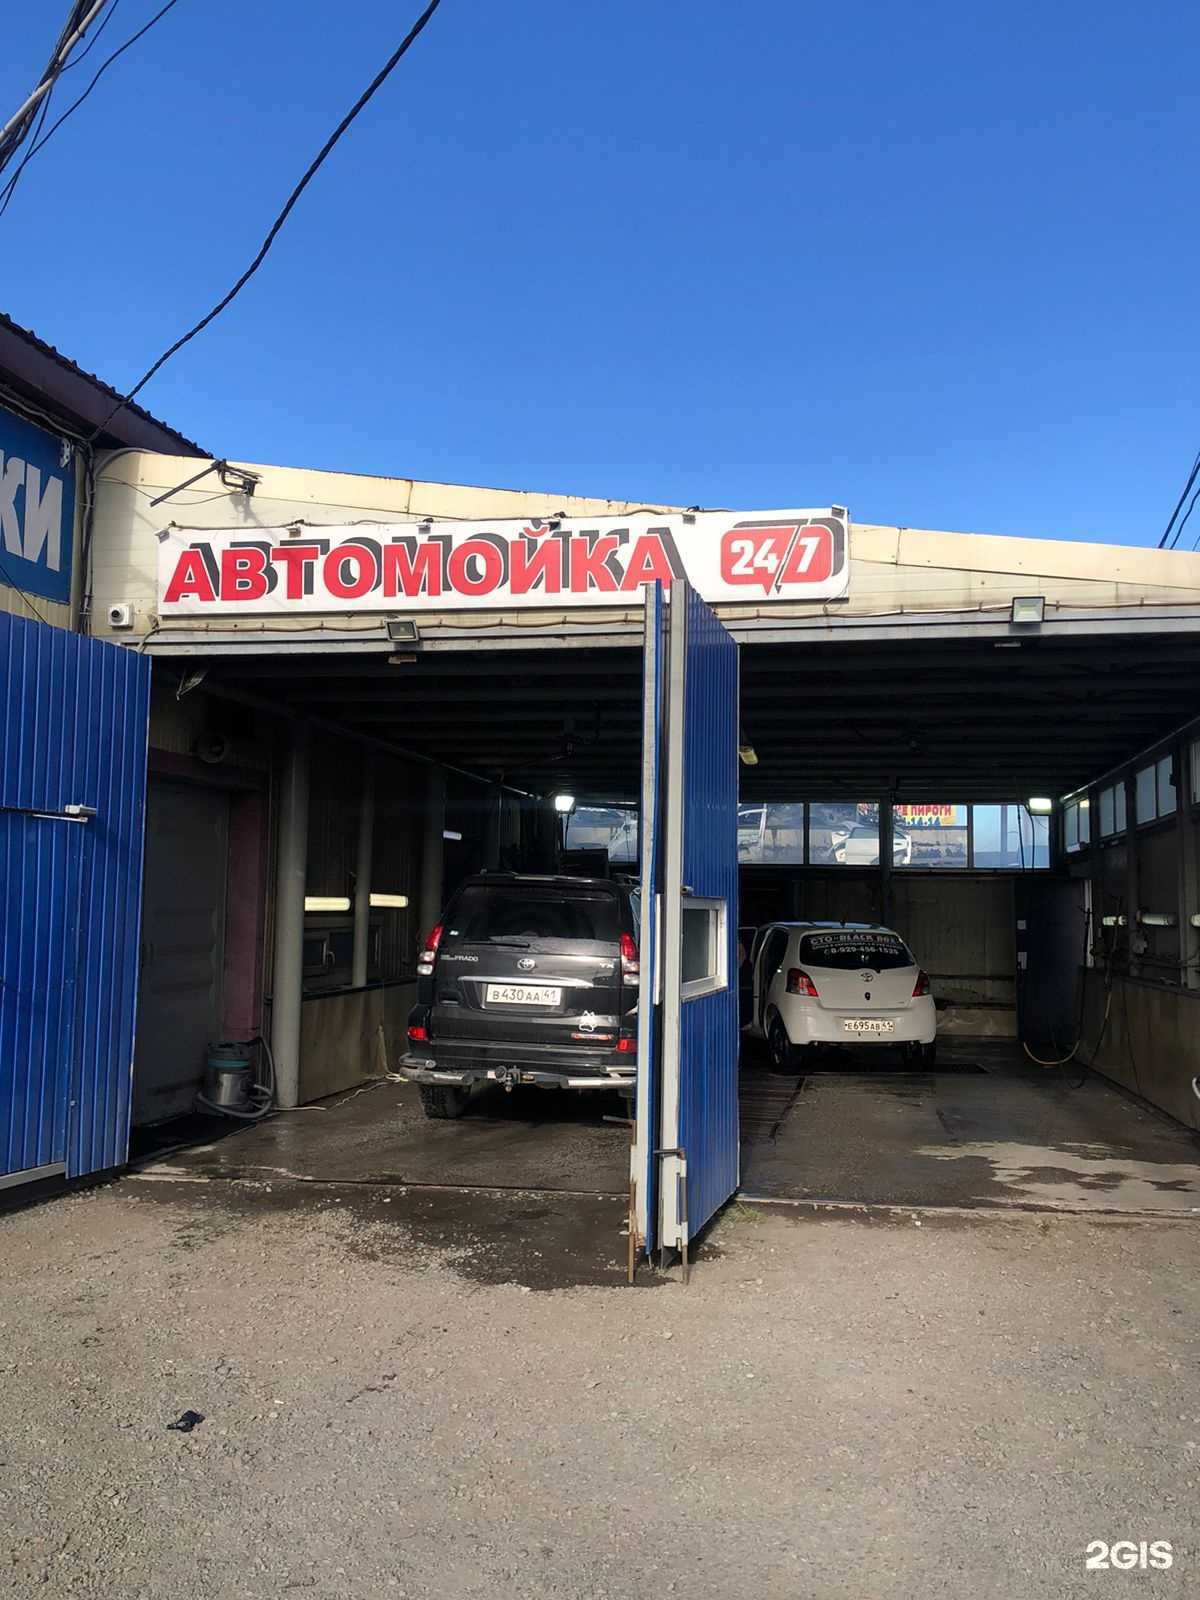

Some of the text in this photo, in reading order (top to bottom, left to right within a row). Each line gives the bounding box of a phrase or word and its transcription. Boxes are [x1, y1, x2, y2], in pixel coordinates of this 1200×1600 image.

[163, 524, 828, 603] АВТОМОЙКА 24/7
[911, 805, 952, 817] ПИРОГИ
